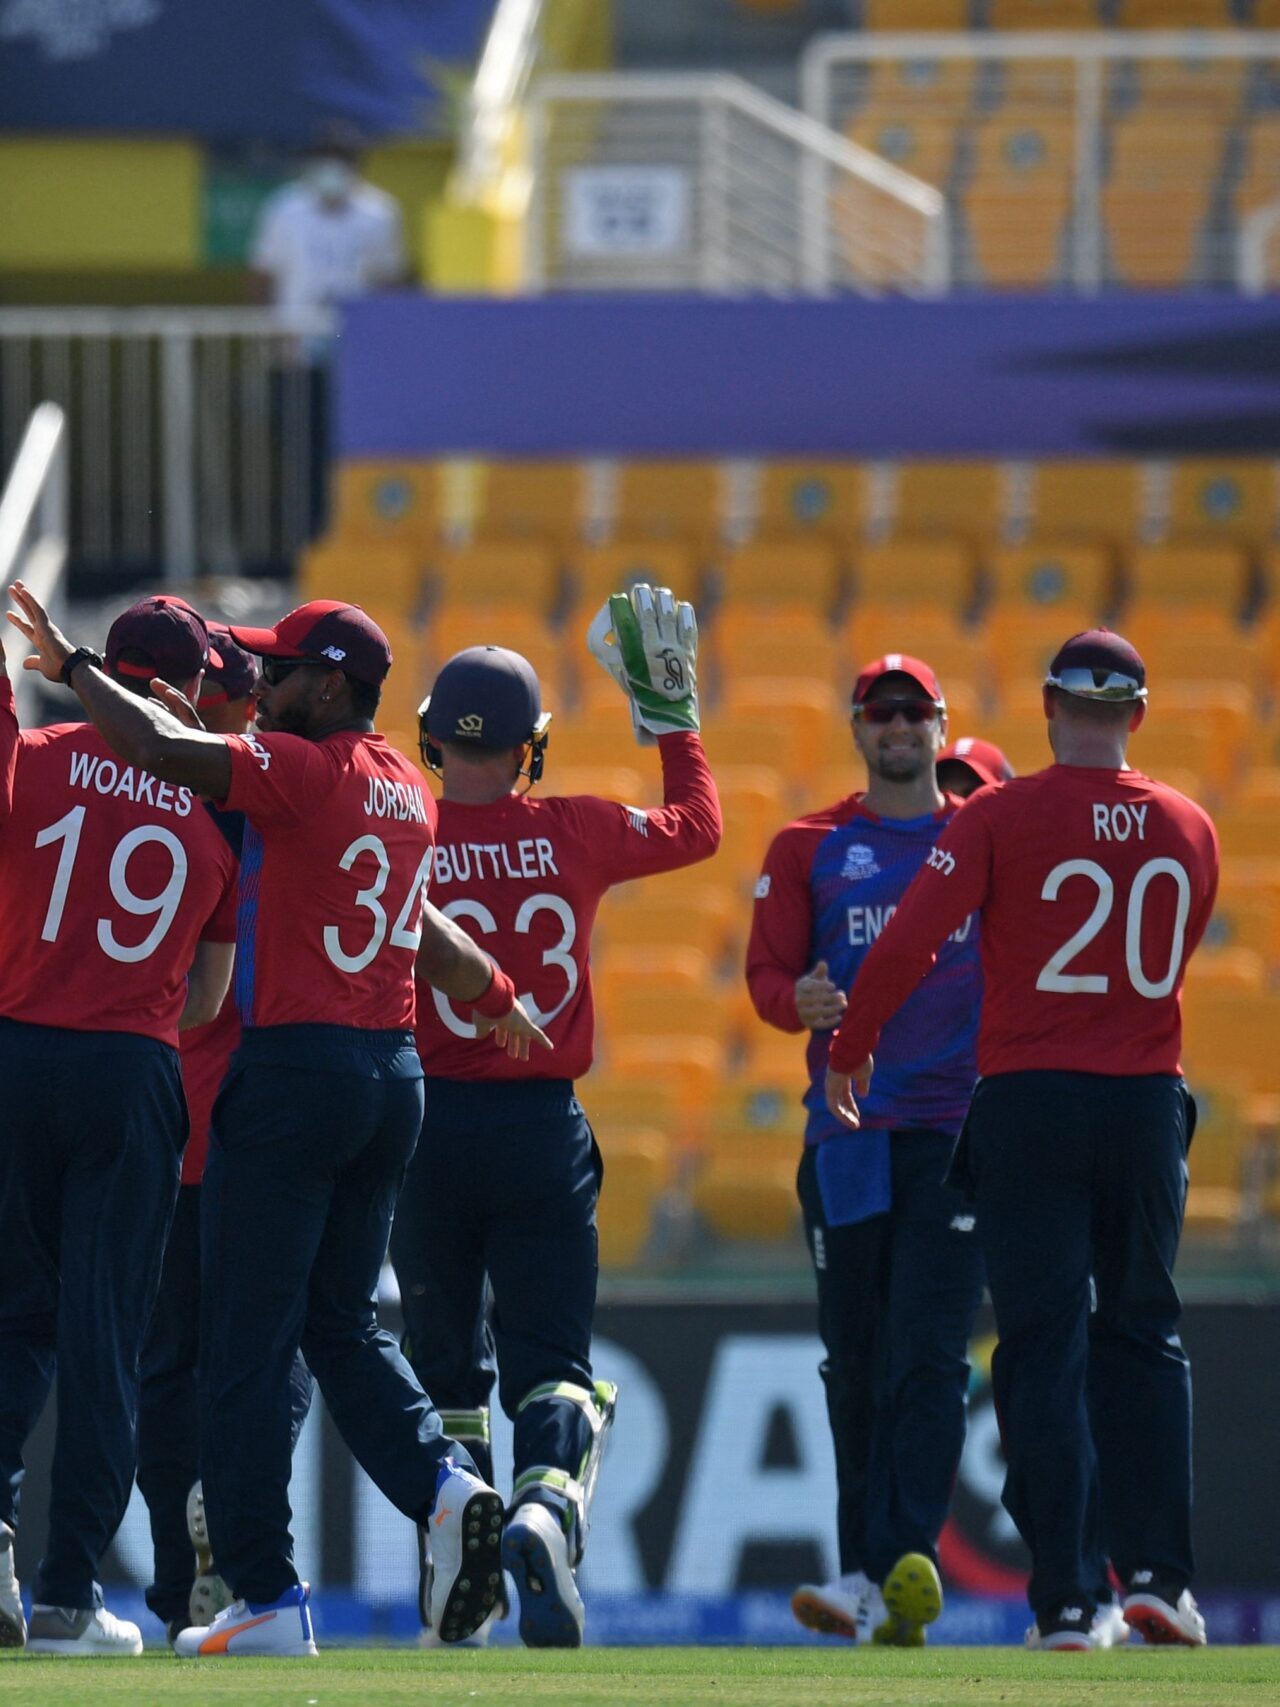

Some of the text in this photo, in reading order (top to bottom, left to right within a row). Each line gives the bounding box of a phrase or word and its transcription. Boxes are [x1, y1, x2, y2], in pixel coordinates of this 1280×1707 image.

[69, 751, 194, 817] WOAKES
[363, 776, 429, 825] JORDAN
[1092, 804, 1148, 841] ROY
[35, 804, 198, 963] 19
[434, 837, 560, 884] BUTTLER
[323, 834, 435, 973] 34
[1035, 857, 1191, 999] 20
